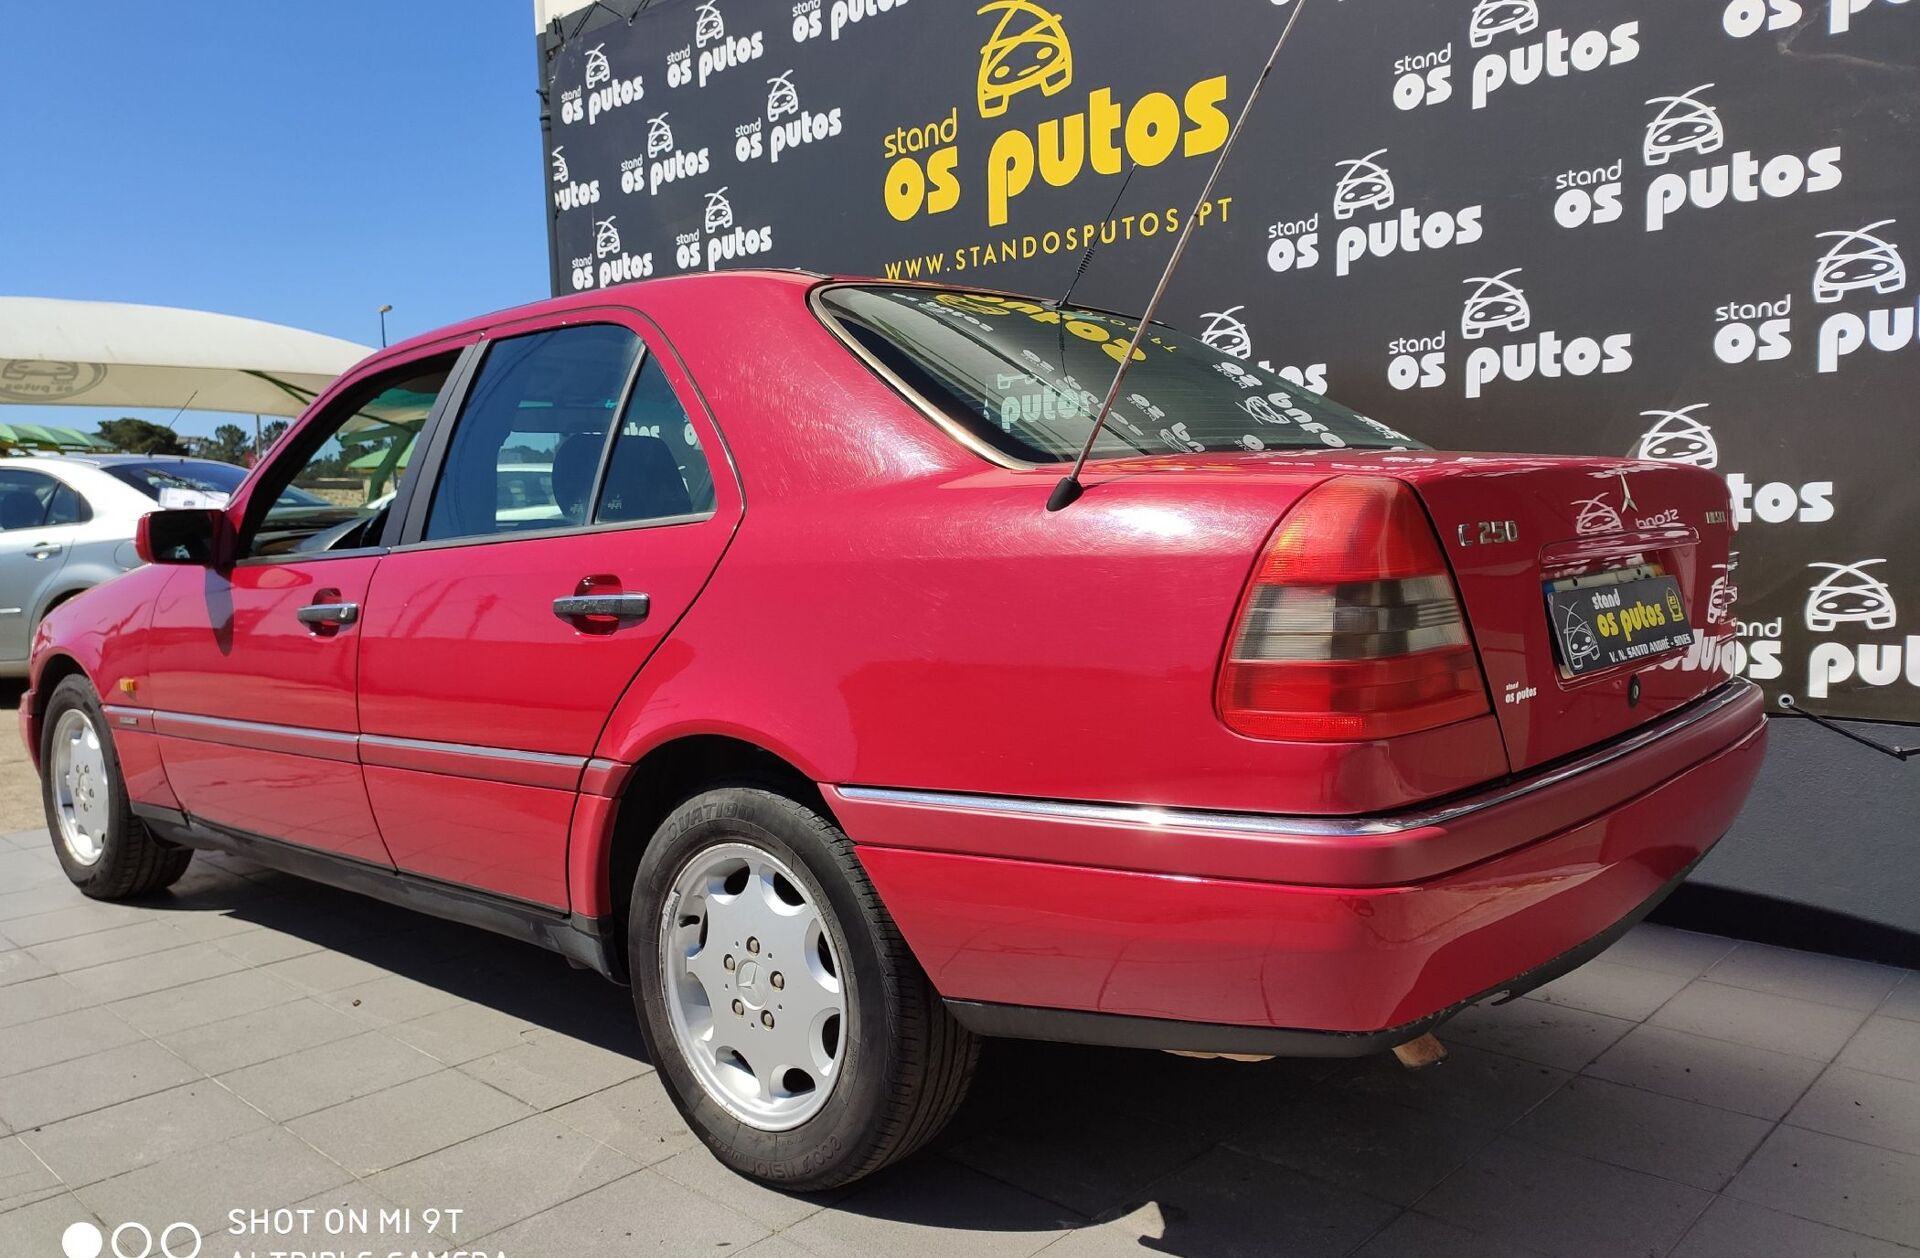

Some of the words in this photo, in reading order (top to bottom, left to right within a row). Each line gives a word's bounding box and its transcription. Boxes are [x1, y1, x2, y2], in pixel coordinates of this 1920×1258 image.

[792, 9, 822, 42] os
[1722, 0, 1802, 38] os
[667, 44, 690, 65] stand
[667, 59, 692, 88] os
[698, 31, 764, 87] putos
[1393, 65, 1452, 110] os
[1472, 21, 1640, 110] putos
[1394, 43, 1451, 74] stand
[561, 87, 581, 103] stand
[561, 100, 583, 125] os
[588, 76, 644, 125] putos
[735, 117, 761, 138] stand
[735, 132, 763, 163] os
[770, 108, 842, 163] putos
[884, 107, 957, 158] stand
[620, 154, 643, 172] stand
[884, 146, 961, 222] os
[987, 75, 1230, 227] putos
[620, 167, 645, 195] os
[650, 148, 710, 195] putos
[1554, 182, 1622, 228] os
[1646, 146, 1842, 232] putos
[1556, 159, 1622, 190] stand
[676, 229, 700, 245] stand
[885, 197, 1233, 280] WWW.STANDOSPUTOSPT
[1267, 233, 1319, 272] os
[1336, 205, 1483, 277] putos
[1268, 213, 1318, 238] stand
[572, 254, 593, 269] stand
[676, 241, 701, 270] os
[708, 226, 773, 271] putos
[572, 264, 594, 290] os
[599, 253, 653, 288] putos
[1715, 294, 1791, 321] stand
[1389, 331, 1446, 355] stand
[1714, 318, 1792, 364] os
[1817, 295, 1920, 373] pu
[1387, 351, 1446, 391] os
[1465, 331, 1633, 399] putos
[1727, 473, 1835, 523] tos
[1458, 524, 1472, 547] C
[1478, 520, 1519, 545] 250
[1591, 588, 1621, 610] stand
[1596, 612, 1619, 638] os
[1619, 601, 1666, 642] putos
[1736, 617, 1782, 637] and
[1627, 643, 1649, 659] SANTO
[1516, 687, 1537, 704] putos
